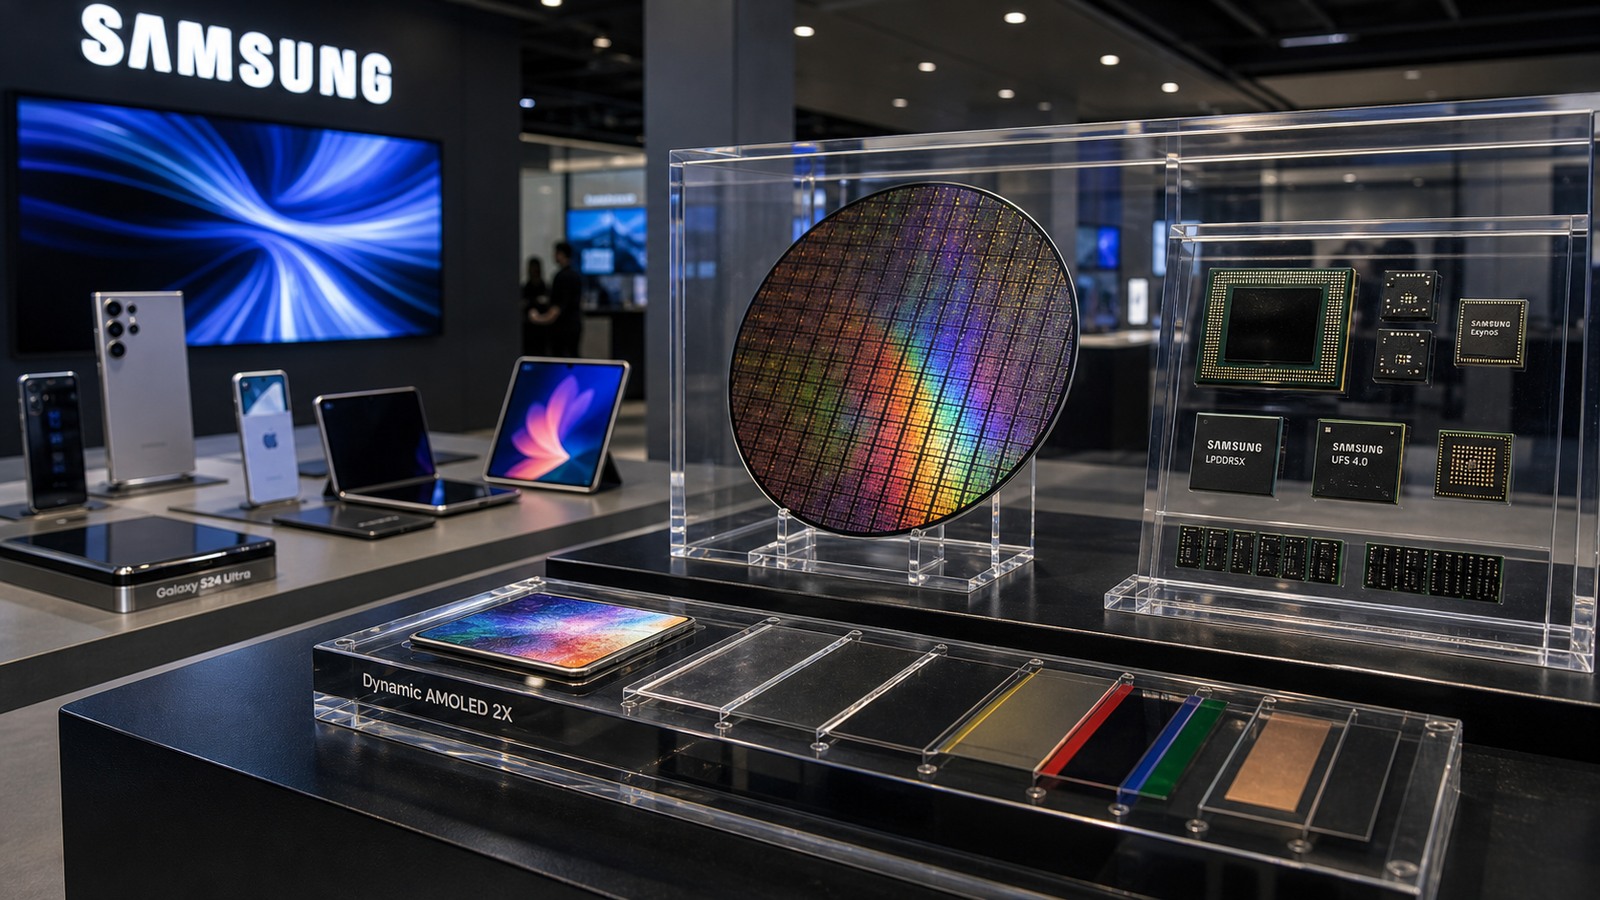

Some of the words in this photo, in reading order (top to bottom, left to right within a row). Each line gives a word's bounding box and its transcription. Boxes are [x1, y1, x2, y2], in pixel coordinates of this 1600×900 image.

[81, 3, 393, 105] SAMSUNG
[1207, 439, 1263, 453] SAMSUNG
[1332, 442, 1384, 455] SAMSUNG
[1331, 455, 1350, 466] UFS
[1352, 457, 1369, 467] 4.0
[156, 581, 199, 599] Galaxy
[200, 575, 222, 589] S24
[223, 570, 251, 584] Ultra
[362, 672, 422, 700] Dynamic
[425, 688, 488, 716] AMOLED
[492, 703, 513, 723] 2X
